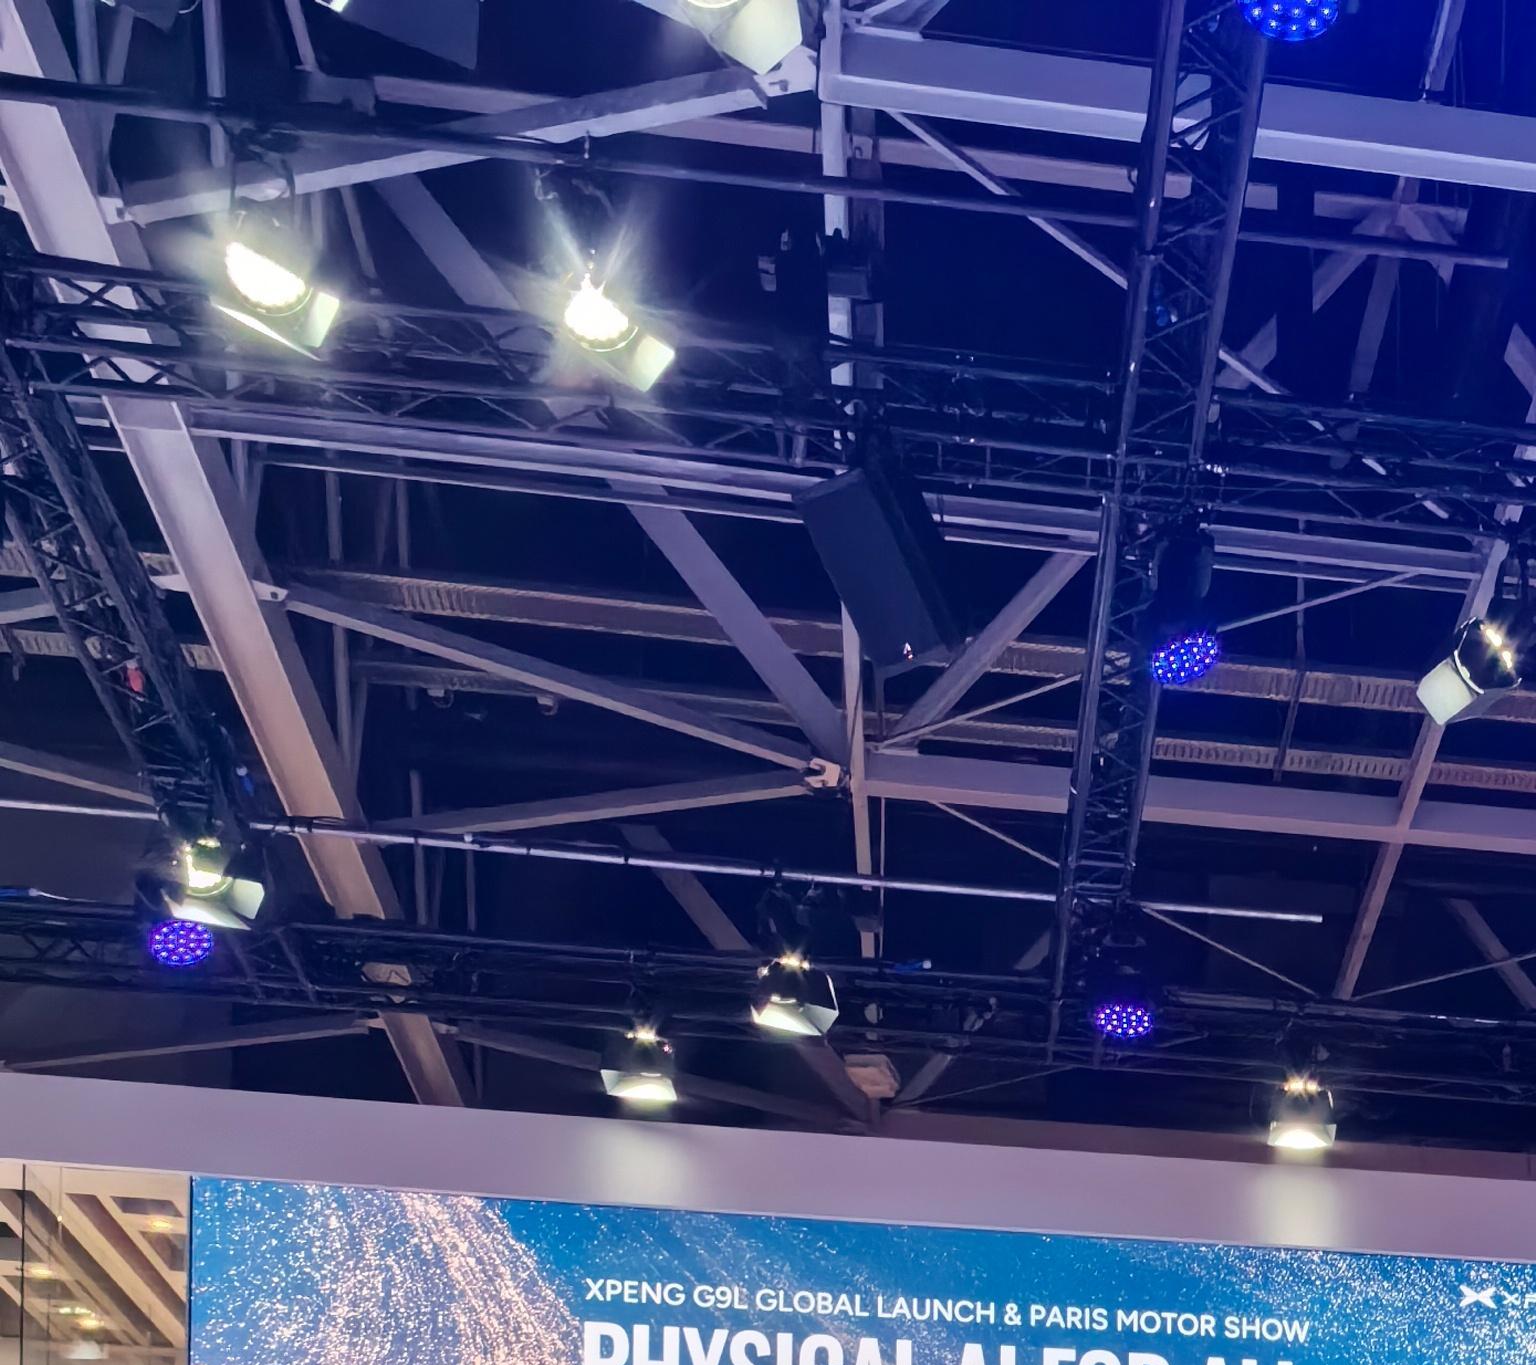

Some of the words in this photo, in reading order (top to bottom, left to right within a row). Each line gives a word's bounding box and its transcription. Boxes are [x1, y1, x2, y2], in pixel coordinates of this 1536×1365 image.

[585, 1278, 686, 1306] XPENG
[693, 1284, 749, 1310] G9L
[755, 1288, 869, 1317] GLOBAL
[877, 1295, 996, 1324] LAUNCH
[1003, 1304, 1022, 1326] &
[1030, 1304, 1109, 1331] PARIS
[1116, 1309, 1216, 1338] MOTOR
[1224, 1315, 1310, 1344] SHOW
